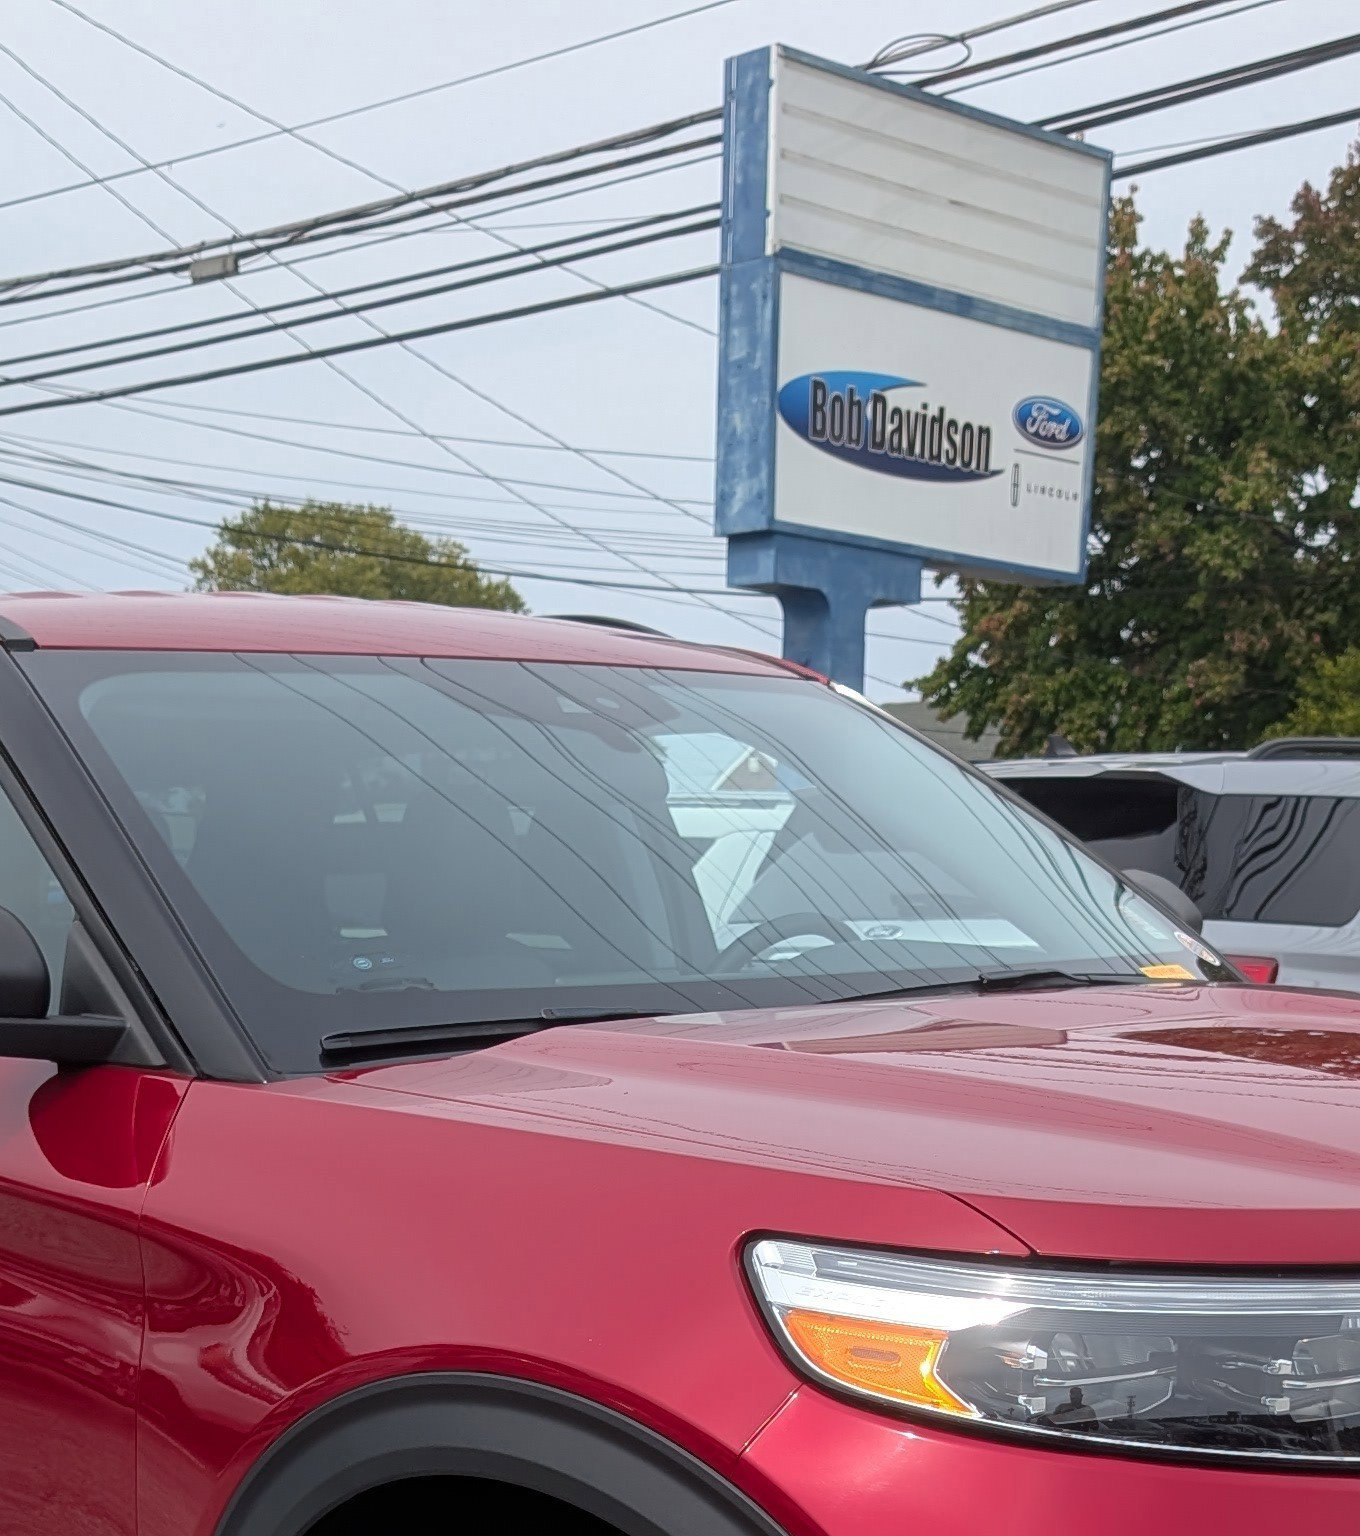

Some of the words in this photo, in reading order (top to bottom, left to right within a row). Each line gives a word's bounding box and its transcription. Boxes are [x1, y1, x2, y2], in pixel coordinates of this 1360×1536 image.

[808, 376, 865, 451] Bob
[868, 389, 993, 474] Davidson
[1025, 402, 1072, 442] Ford
